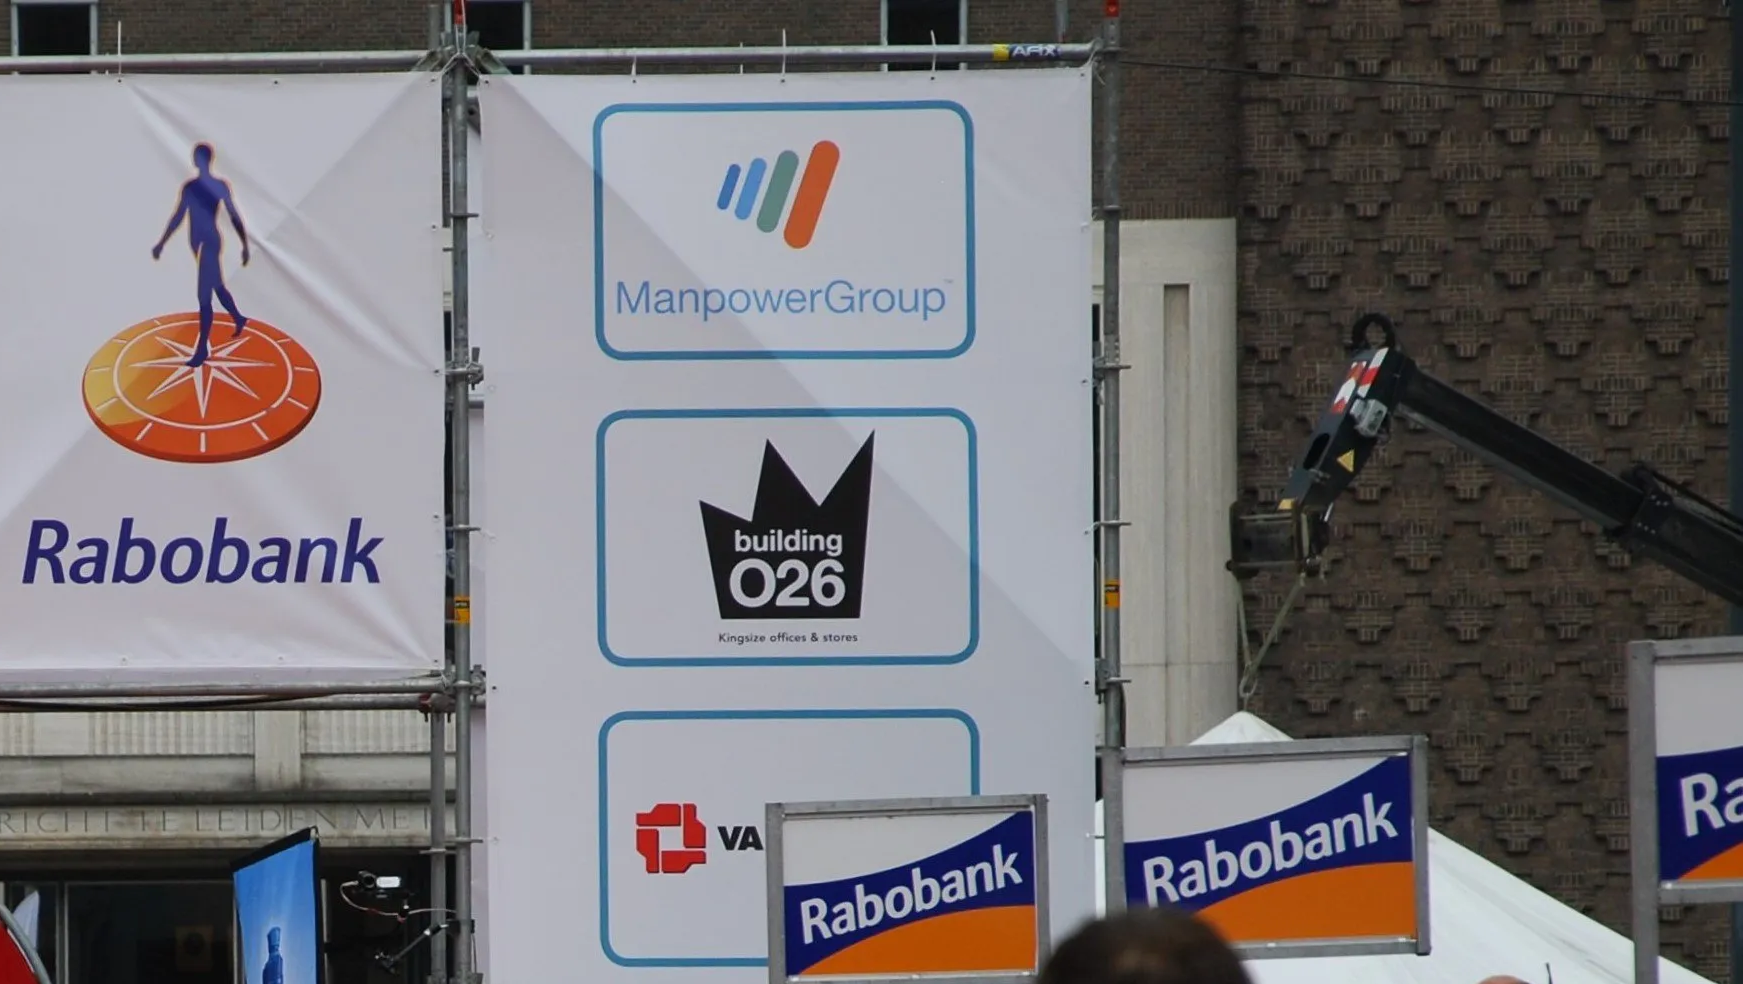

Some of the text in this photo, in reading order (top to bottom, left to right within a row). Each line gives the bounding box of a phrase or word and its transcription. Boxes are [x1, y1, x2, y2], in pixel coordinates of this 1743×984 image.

[1012, 44, 1056, 57] AFIX
[22, 517, 384, 584] Rabobank
[734, 529, 843, 557] building
[718, 632, 858, 646] Kingsize offices & stores
[196, 807, 336, 832] LEIDEN
[1143, 792, 1399, 908] Rabobank
[800, 843, 1023, 945] Rabobank
